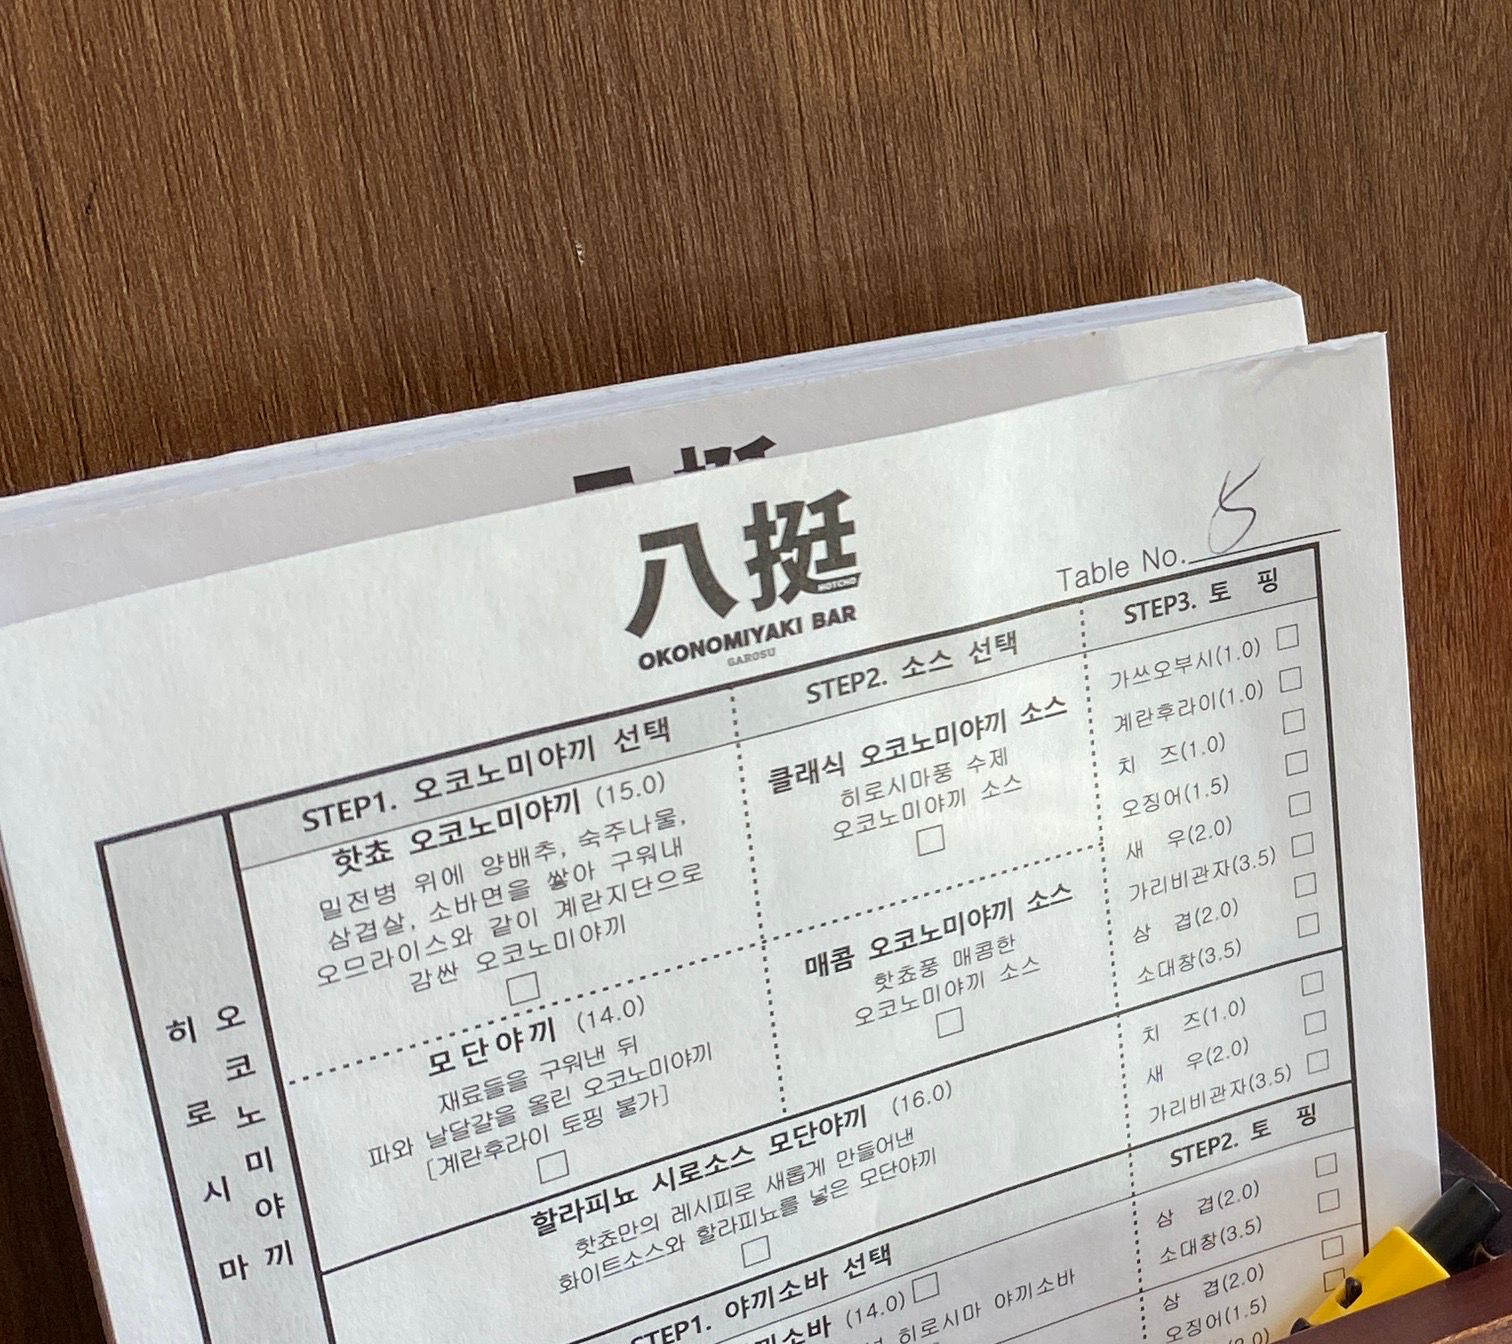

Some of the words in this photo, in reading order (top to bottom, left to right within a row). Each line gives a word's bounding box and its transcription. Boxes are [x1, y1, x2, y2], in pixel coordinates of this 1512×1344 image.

[1056, 557, 1129, 591] Table
[1143, 547, 1185, 572] No.
[1124, 591, 1196, 624] STEP3.
[638, 616, 803, 670] OKONOMIYAKI
[811, 605, 856, 630] BAR
[806, 667, 887, 704] STEP2.
[902, 649, 953, 679] 소스
[969, 630, 1017, 664] 선택
[1111, 637, 1260, 689] 가쓰오부시(1.0)
[1114, 680, 1263, 732] 계란후라이(1.0)
[302, 790, 396, 832] STEP1.
[414, 734, 595, 802] 오코노미야끼
[614, 716, 670, 753] 선택
[768, 751, 844, 794] 클래식
[860, 708, 1006, 768] 오코노미야끼
[1020, 696, 1067, 725] 소스
[841, 762, 952, 807] 히로시마풍
[967, 747, 1007, 773] 수제
[332, 840, 394, 877] 핫쵸
[409, 788, 580, 854] 오코노미야끼
[597, 771, 664, 808] (15.0)
[834, 788, 965, 840] 오코노미야끼
[982, 774, 1022, 799] 소스
[1123, 774, 1228, 818] 오징어(1.5)
[320, 882, 395, 921] 밀전병
[415, 863, 464, 893] 위에
[481, 841, 565, 876] 양배추,
[579, 808, 685, 847] 숙주나물,
[329, 912, 415, 950] 삼겹살,
[430, 879, 530, 922] 소바면을
[548, 860, 594, 890] 쌓아
[611, 836, 682, 871] 구워내
[1129, 846, 1275, 901] 가리비관자(3.5)
[318, 925, 472, 986] 오므라이스와
[489, 907, 537, 937] 같이
[555, 863, 703, 918] 계란지단으로
[410, 961, 458, 992] 감싼
[477, 914, 625, 973] 오코노미야끼
[805, 945, 855, 976] 매콤
[869, 897, 1013, 960] 오코노미야끼
[1027, 883, 1072, 912] 소스
[1138, 938, 1241, 984] 소대창(3.5)
[856, 970, 984, 1026] 오코노미야끼
[1000, 956, 1040, 981] 소스
[874, 957, 938, 993] 핫쵸풍
[953, 934, 1015, 967] 매콤한
[428, 1017, 555, 1077] 모단야끼
[578, 994, 644, 1033] (14.0)
[438, 1069, 527, 1113] 재료들을
[540, 1045, 606, 1079] 구워낸
[618, 1035, 637, 1056] 뒤
[368, 1137, 413, 1167] 파와
[426, 1105, 516, 1149] 날달걀을
[528, 1086, 571, 1116] 올린
[584, 1042, 711, 1098] 오코노미야끼
[427, 1123, 548, 1180] [계란후라이
[562, 1105, 603, 1135] 토핑
[617, 1084, 668, 1118] 불가]
[1150, 1064, 1291, 1123] 가리비관자(3.5)
[530, 1187, 638, 1237] 할라피뇨
[652, 1145, 755, 1191] 시로소스
[769, 1104, 866, 1155] 모단야끼
[893, 1080, 951, 1116] (16.0)
[576, 1213, 659, 1259] 핫쵸만의
[672, 1182, 755, 1223] 레시피로
[767, 1157, 825, 1192] 새롭게
[837, 1127, 914, 1168] 만들어낸
[559, 1234, 685, 1293] 화이트소스와
[697, 1195, 799, 1245] 할라피뇨를
[810, 1179, 848, 1206] 넣은
[861, 1147, 935, 1188] 모단야끼
[725, 1267, 829, 1319] 야끼소바
[843, 1242, 891, 1279] 선택
[846, 1291, 904, 1328] (14.0)
